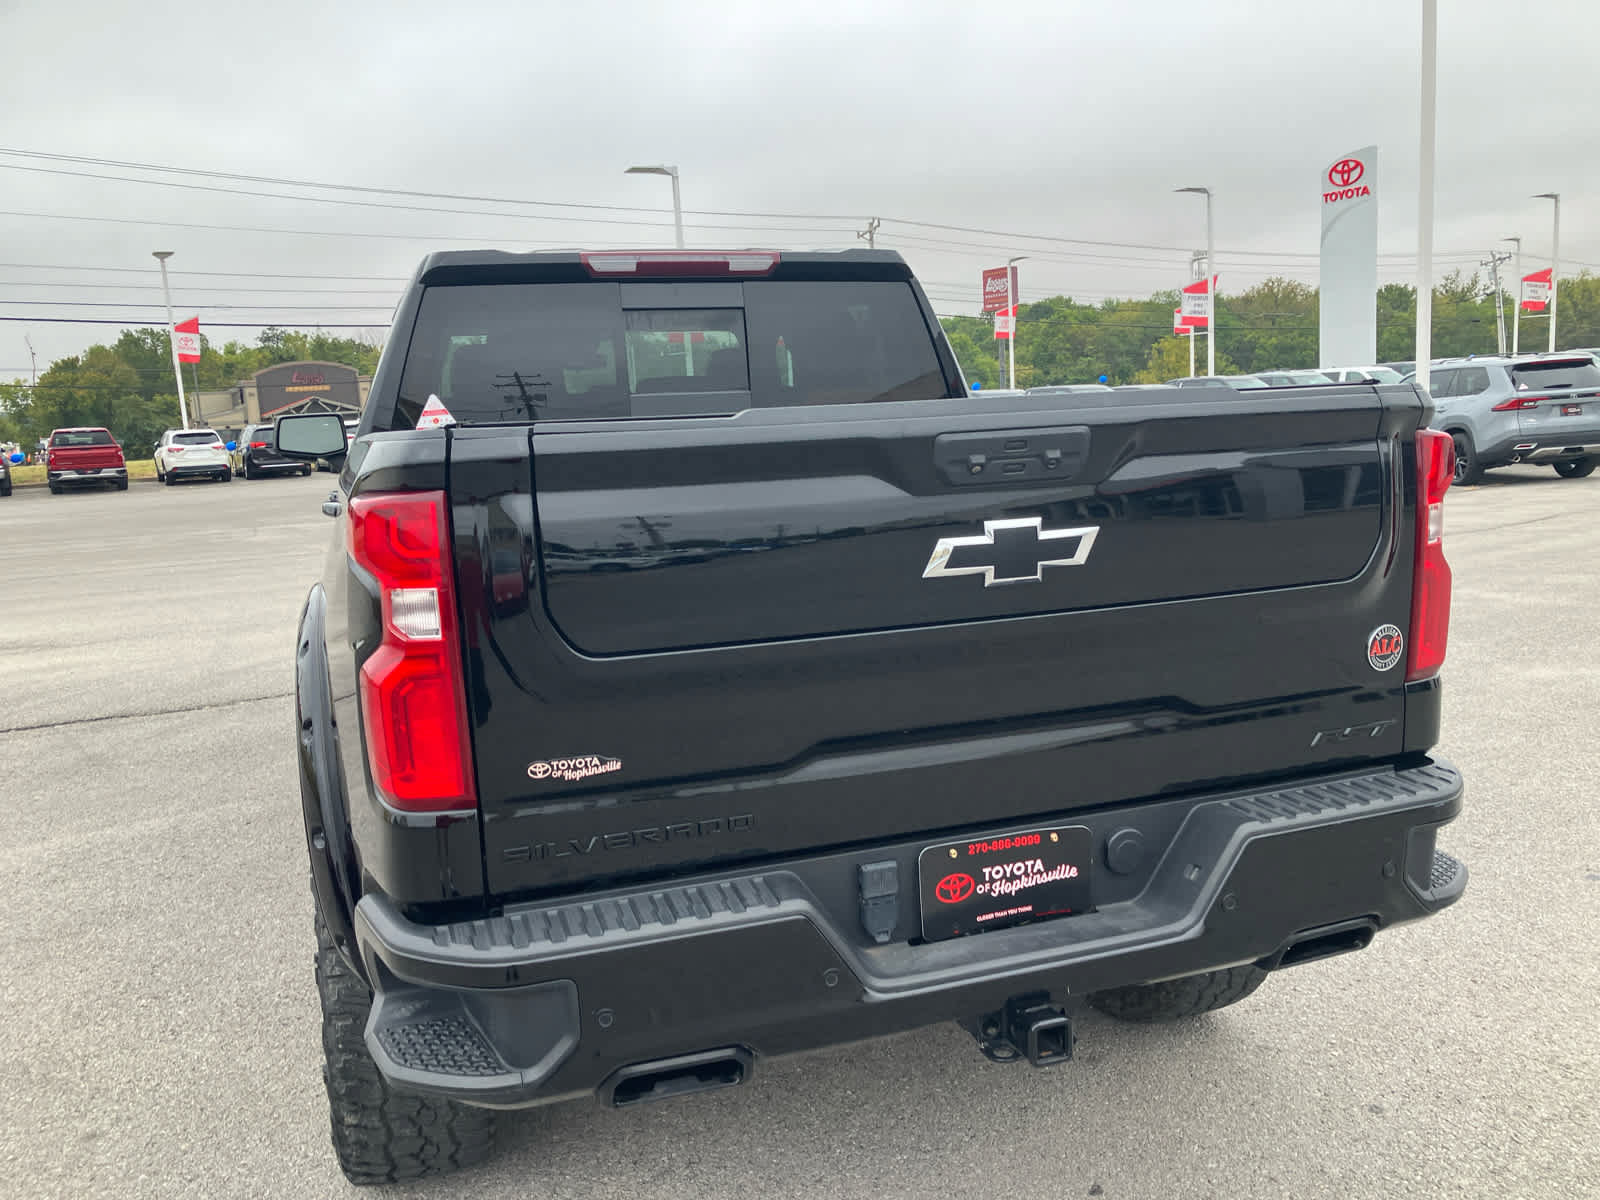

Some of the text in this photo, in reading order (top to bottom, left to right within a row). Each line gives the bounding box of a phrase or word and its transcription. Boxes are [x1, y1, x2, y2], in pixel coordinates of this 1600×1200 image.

[1323, 185, 1370, 204] TOYOTA
[1370, 635, 1400, 656] ALC
[551, 756, 600, 770] TOYOTA
[563, 760, 622, 781] Hopkinsville
[503, 814, 756, 862] SILVERADO
[976, 864, 1078, 897] OF Hopkinsville
[982, 859, 1044, 881] TOYOTA
[994, 909, 1008, 918] THAN
[1008, 908, 1018, 916] YOU
